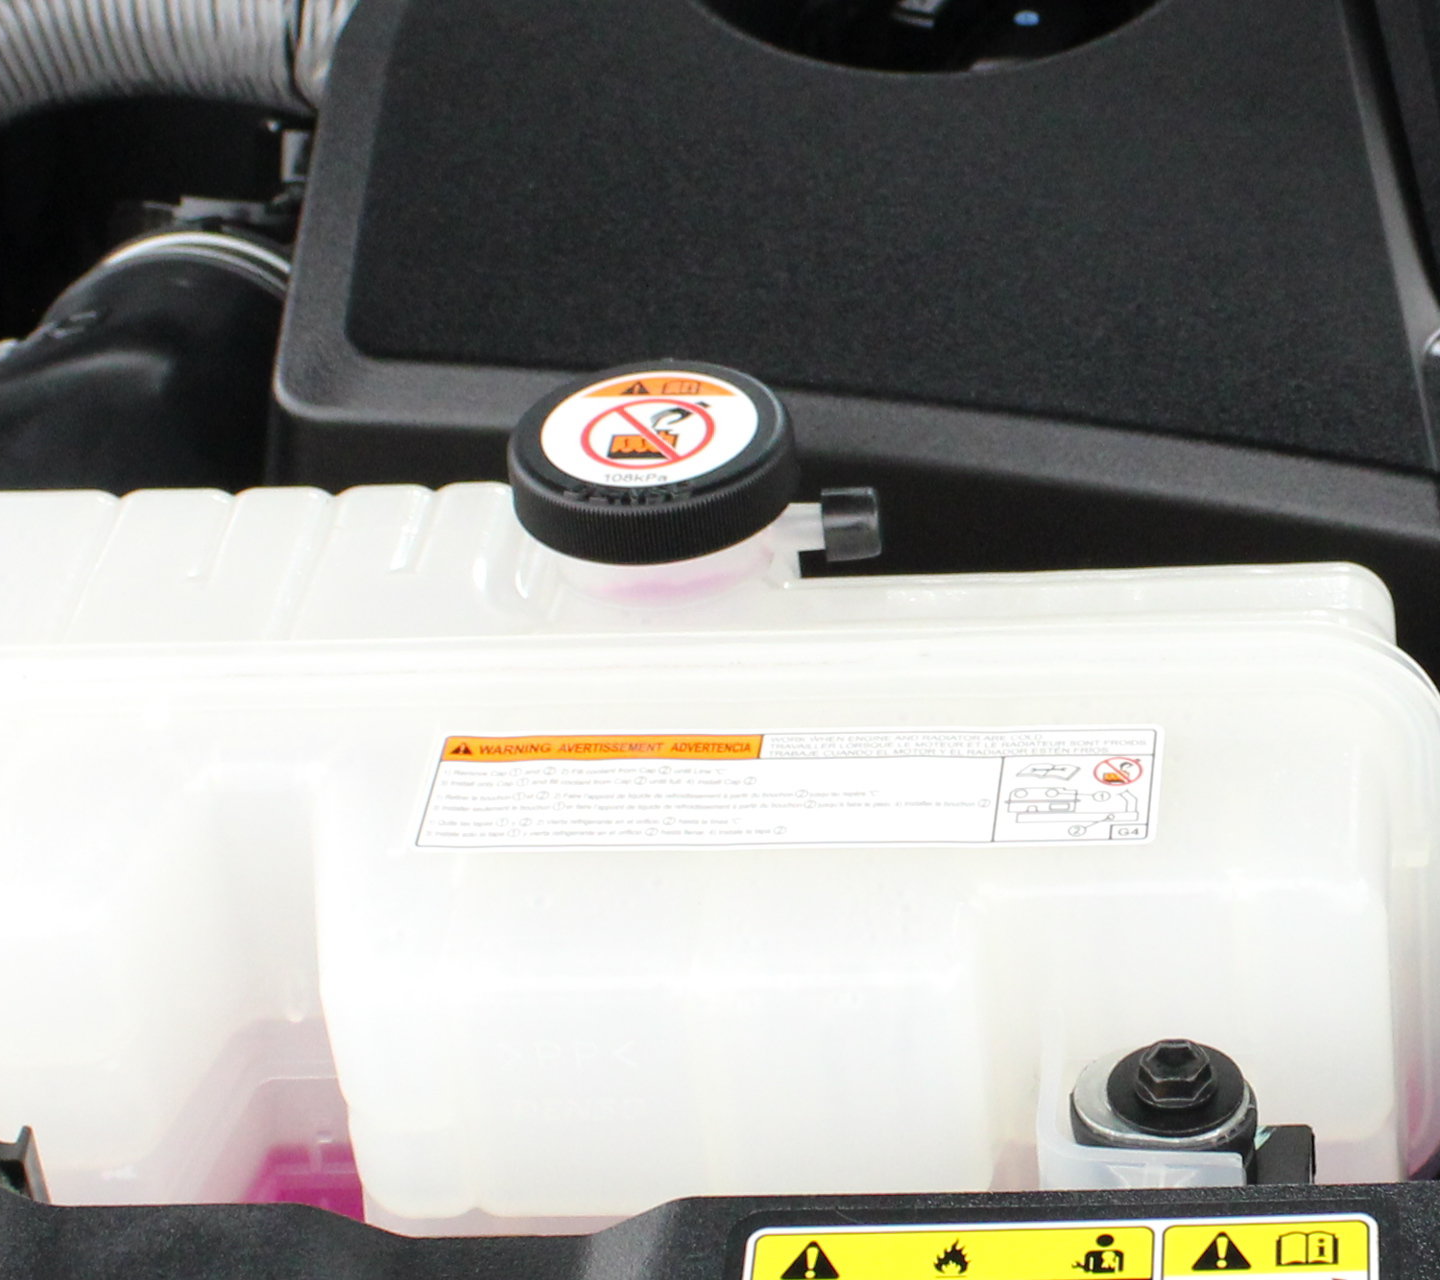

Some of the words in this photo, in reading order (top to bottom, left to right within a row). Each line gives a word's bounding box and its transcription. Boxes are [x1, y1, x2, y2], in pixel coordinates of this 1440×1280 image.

[602, 473, 669, 484] 108kPa
[478, 742, 552, 756] WARNING
[558, 741, 664, 755] AVERTISSEMENT
[669, 741, 752, 754] ADVERTENCIA
[1117, 827, 1140, 837] G4
